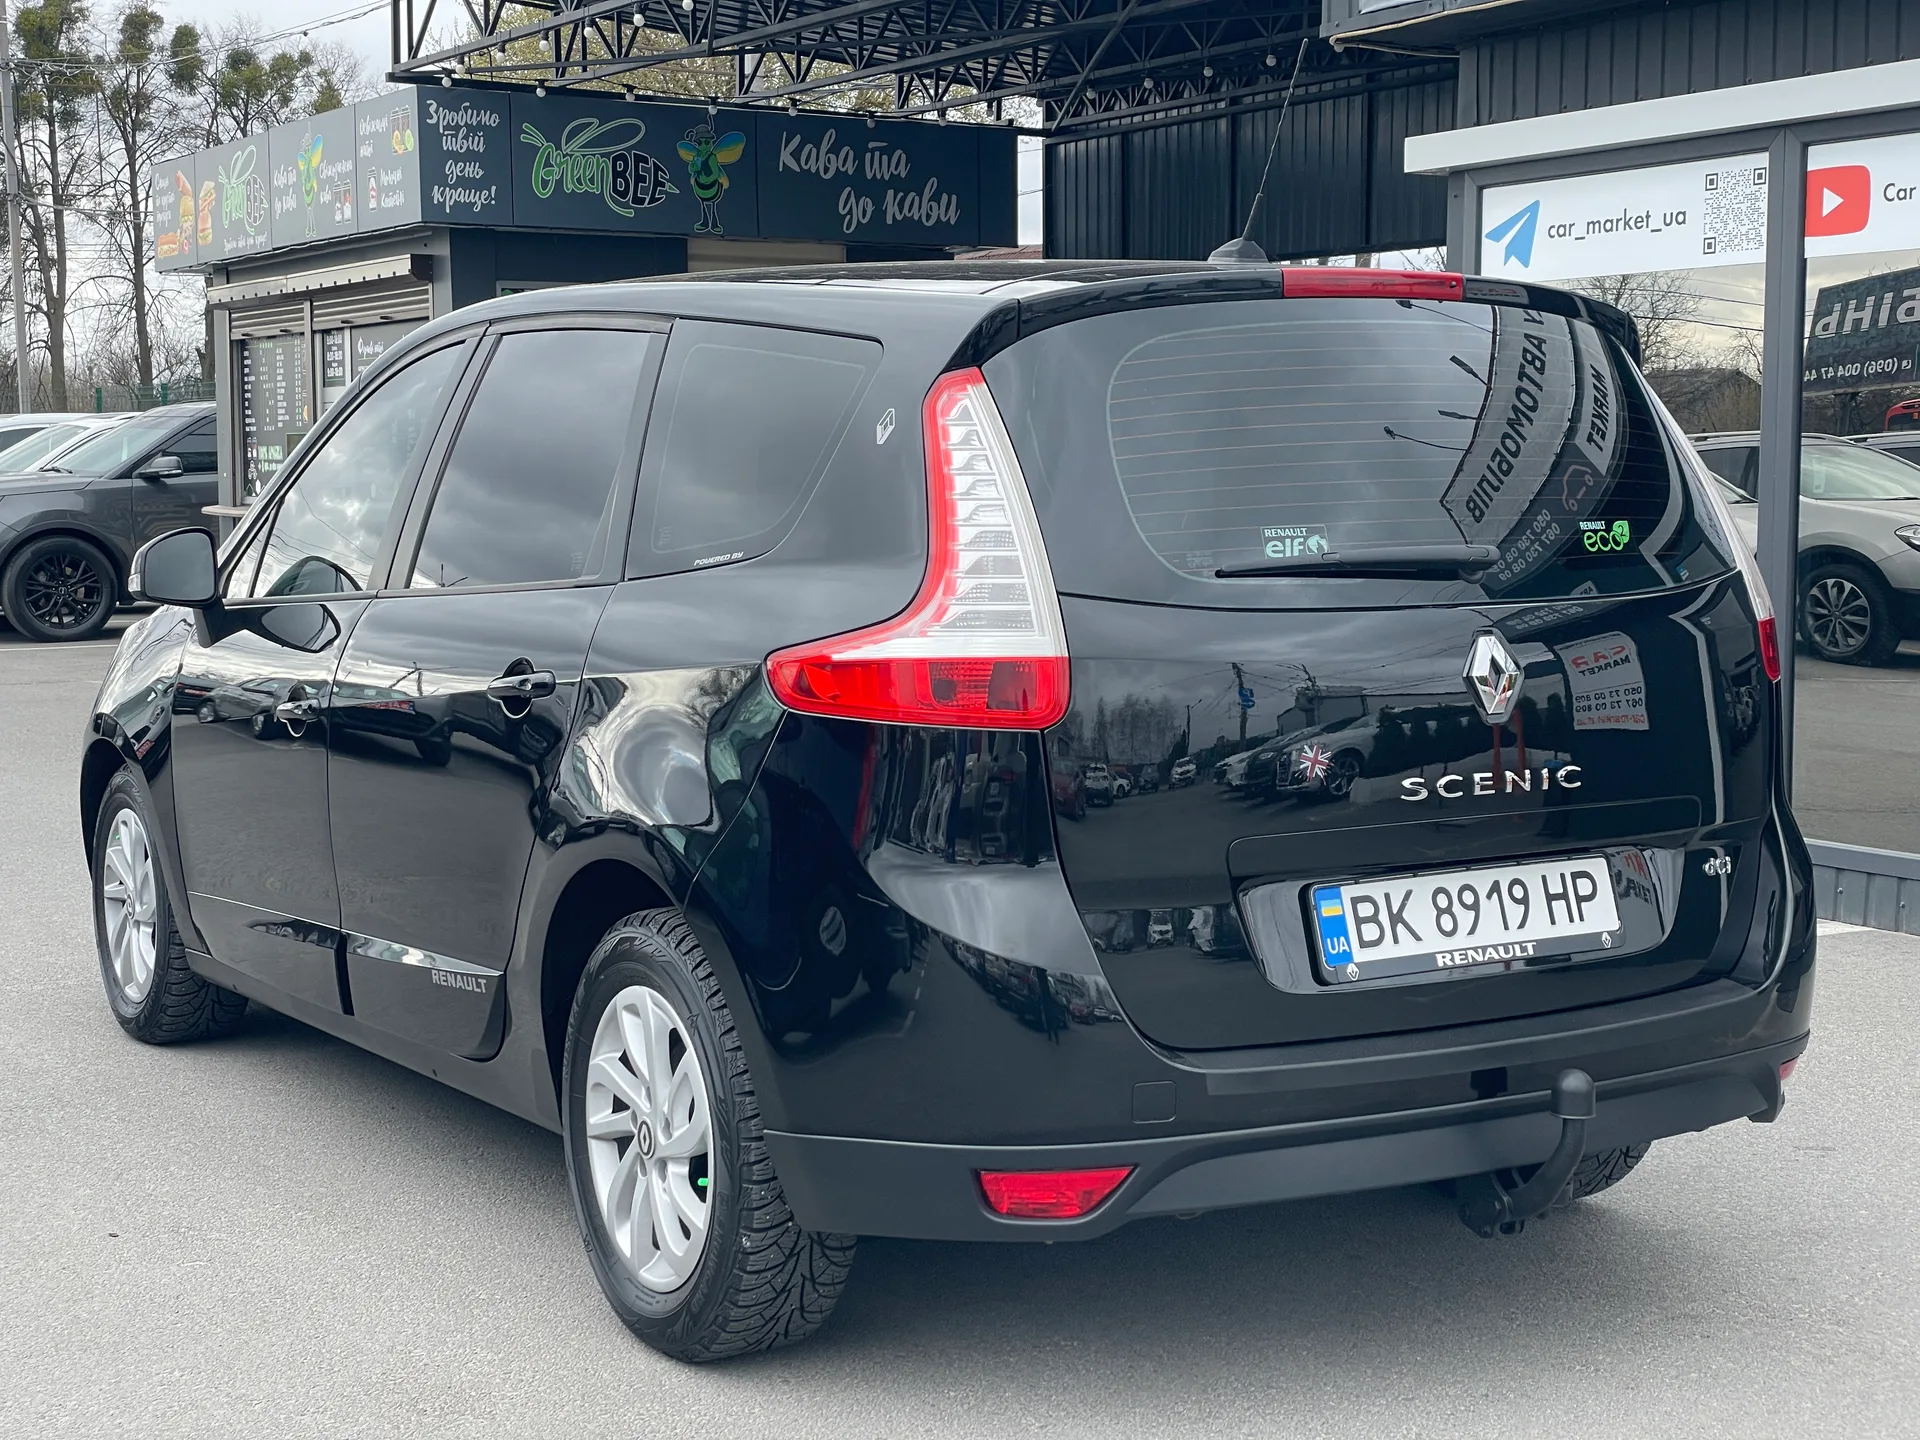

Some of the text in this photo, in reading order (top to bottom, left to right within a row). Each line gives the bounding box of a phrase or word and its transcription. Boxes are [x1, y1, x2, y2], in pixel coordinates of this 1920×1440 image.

[426, 100, 500, 133] Зробимо
[442, 127, 485, 153] твій
[779, 129, 911, 181] Кава та
[446, 160, 484, 184] день
[432, 185, 497, 213] краще!
[1883, 183, 1917, 203] Car
[839, 177, 960, 234] до кави
[1548, 208, 1688, 242] car_market_ua
[1264, 527, 1307, 537] RENAULT
[1579, 521, 1606, 530] RENAULT
[694, 551, 744, 566] POWERED BY
[1265, 537, 1306, 558] elf
[1400, 765, 1582, 801] SCENIC
[1702, 856, 1731, 876] dCi
[1350, 889, 1423, 950] BK
[1431, 876, 1532, 938] 8919
[1541, 870, 1598, 926] HP
[1327, 935, 1350, 956] UA
[1434, 942, 1537, 967] RENAULT
[431, 969, 487, 993] RENAULT
